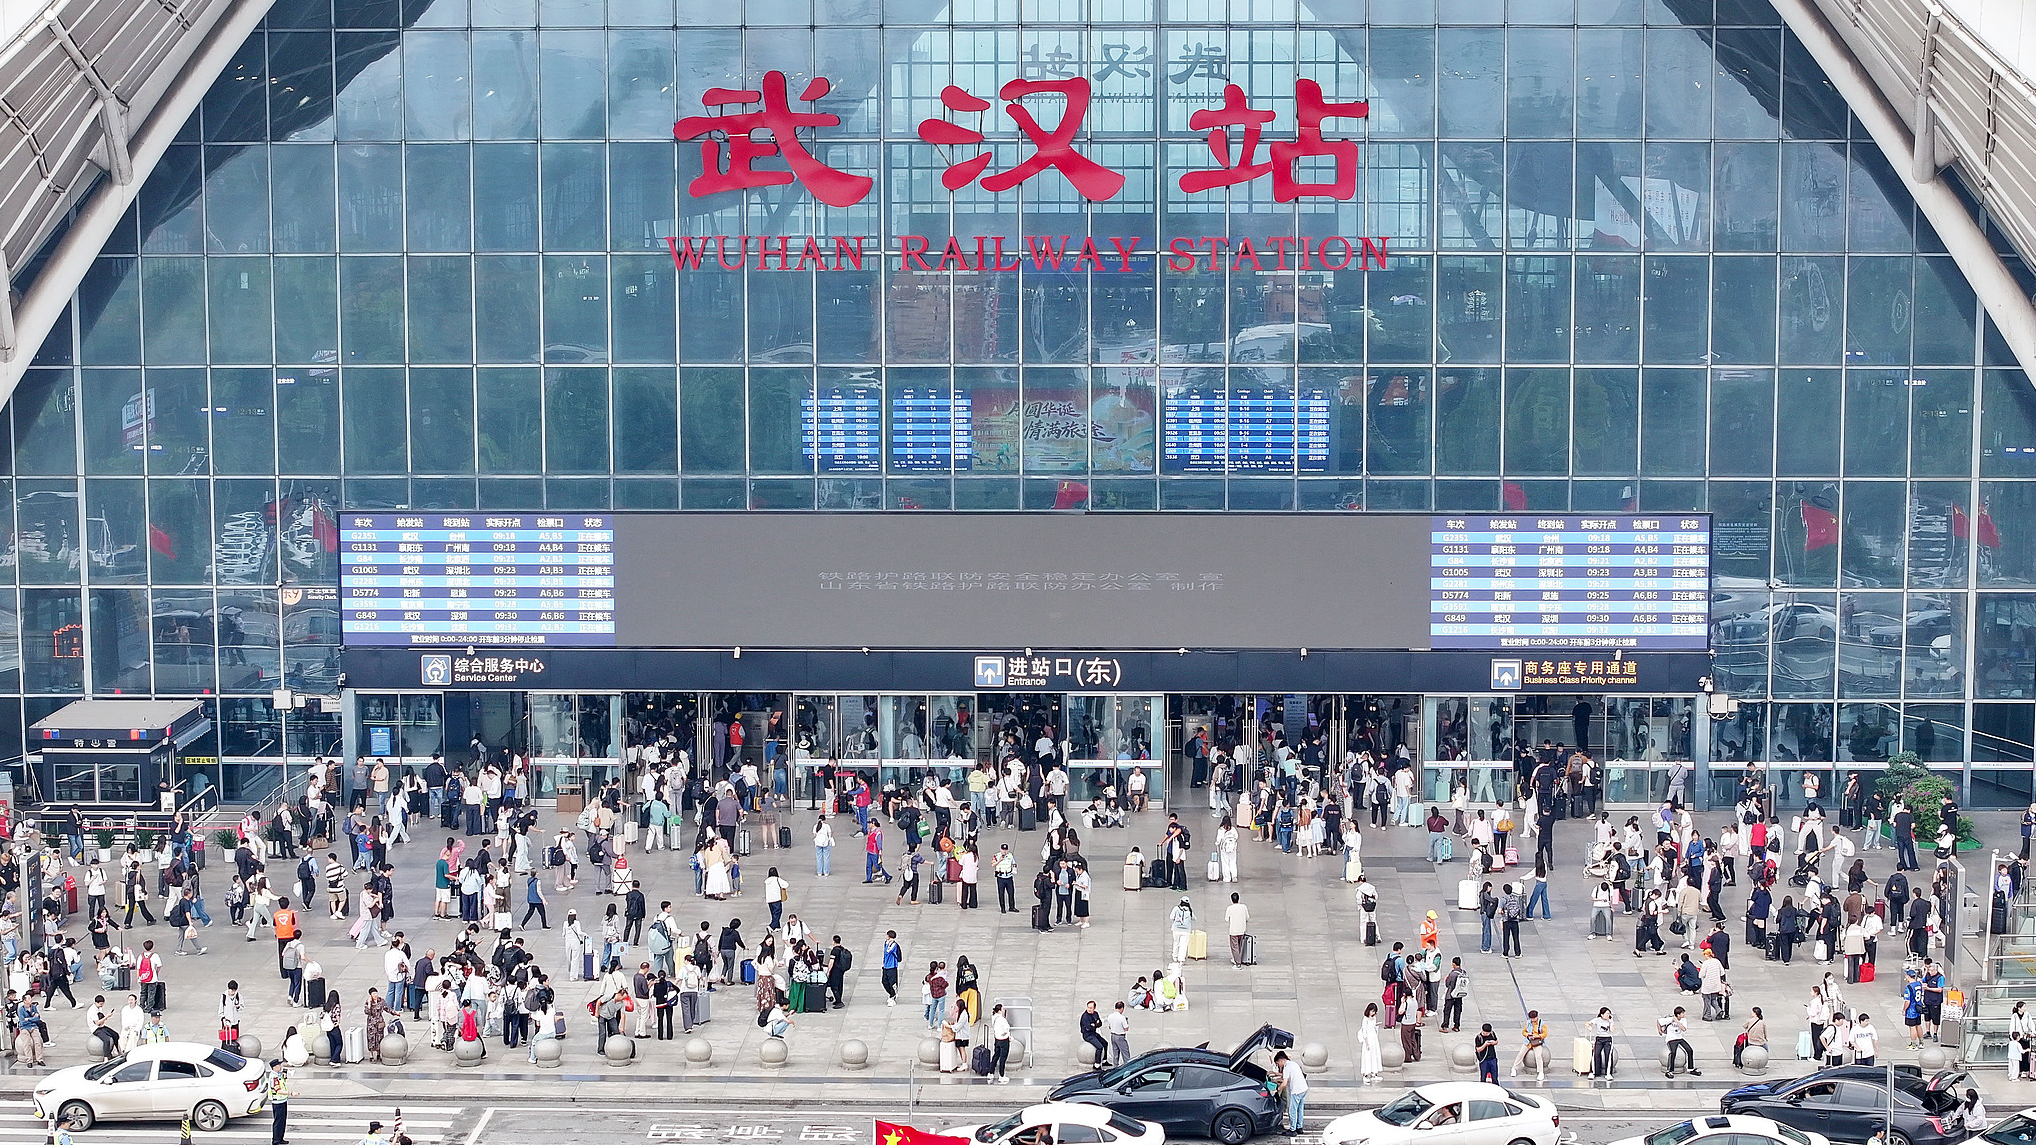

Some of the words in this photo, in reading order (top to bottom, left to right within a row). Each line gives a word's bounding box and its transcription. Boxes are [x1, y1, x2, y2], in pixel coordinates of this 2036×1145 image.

[673, 70, 1369, 207] 武汉站
[666, 236, 862, 271] WUHAN
[897, 235, 1141, 271] RAILWAY
[1169, 236, 1390, 271] STATION
[1023, 421, 1116, 443] 情满旅途
[354, 518, 372, 528] 车次
[397, 518, 423, 528] 始发站
[443, 518, 470, 528] 终到站
[486, 518, 521, 528] 实际开点
[537, 518, 564, 528] 检票口
[584, 518, 602, 528] 状态
[1447, 520, 1465, 530] 车次
[1490, 520, 1517, 530] 始发站
[1537, 520, 1564, 530] 终到站
[1581, 520, 1616, 530] 实际开点
[1633, 520, 1660, 530] 检票口
[1680, 520, 1699, 530] 状态
[351, 543, 377, 552] G1131
[493, 543, 516, 552] 09:18
[539, 543, 563, 552] A4,B4
[1443, 545, 1469, 554] G1131
[1587, 545, 1610, 554] 09:18
[1634, 545, 1658, 554] A4,B4
[494, 555, 516, 563] 09:21
[352, 566, 378, 574] G1005
[402, 566, 420, 575] 武汉
[494, 566, 516, 574] 09:23
[540, 566, 563, 574] A3,B3
[1442, 568, 1469, 577] G1005
[1494, 568, 1511, 577] 武汉
[1587, 568, 1610, 577] 09:23
[1634, 568, 1658, 577] A3,B3
[818, 571, 1180, 581] 铁路护路联防安全稳定办公室
[1198, 571, 1224, 581] 宣
[494, 578, 516, 586] 09:23
[819, 582, 1153, 591] 山东省铁路护路联防办公室
[1171, 581, 1224, 591] 制作
[353, 589, 379, 597] D5774
[494, 589, 516, 597] 09:25
[540, 589, 564, 597] A6,B6
[1442, 591, 1469, 600] D5774
[1587, 591, 1609, 600] 09:25
[1633, 591, 1657, 600] A6,B6
[494, 600, 517, 608] 09:28
[355, 612, 377, 620] G849
[404, 611, 421, 620] 武汉
[495, 612, 517, 620] 09:30
[540, 612, 564, 620] A6,B6
[1445, 614, 1466, 622] G849
[1494, 614, 1511, 623] 武汉
[1586, 614, 1609, 622] 09:30
[1633, 614, 1657, 622] A6,B6
[495, 623, 517, 631] 09:32
[1586, 626, 1608, 634] 09:32
[440, 635, 478, 644] 0:00-24:00
[1530, 638, 1568, 646] 0:00-24:00
[454, 658, 544, 673] 综合服务中心
[1524, 660, 1638, 676] 商务座专用通道
[1008, 656, 1122, 687] 进站口(东)
[454, 674, 486, 682] Service
[488, 674, 517, 682] Center
[1008, 678, 1046, 686] Entrance
[1524, 676, 1558, 684] Business
[1558, 676, 1580, 684] Class
[1580, 676, 1606, 686] Priority
[1607, 676, 1637, 684] channel
[1914, 990, 1922, 1002] 8
